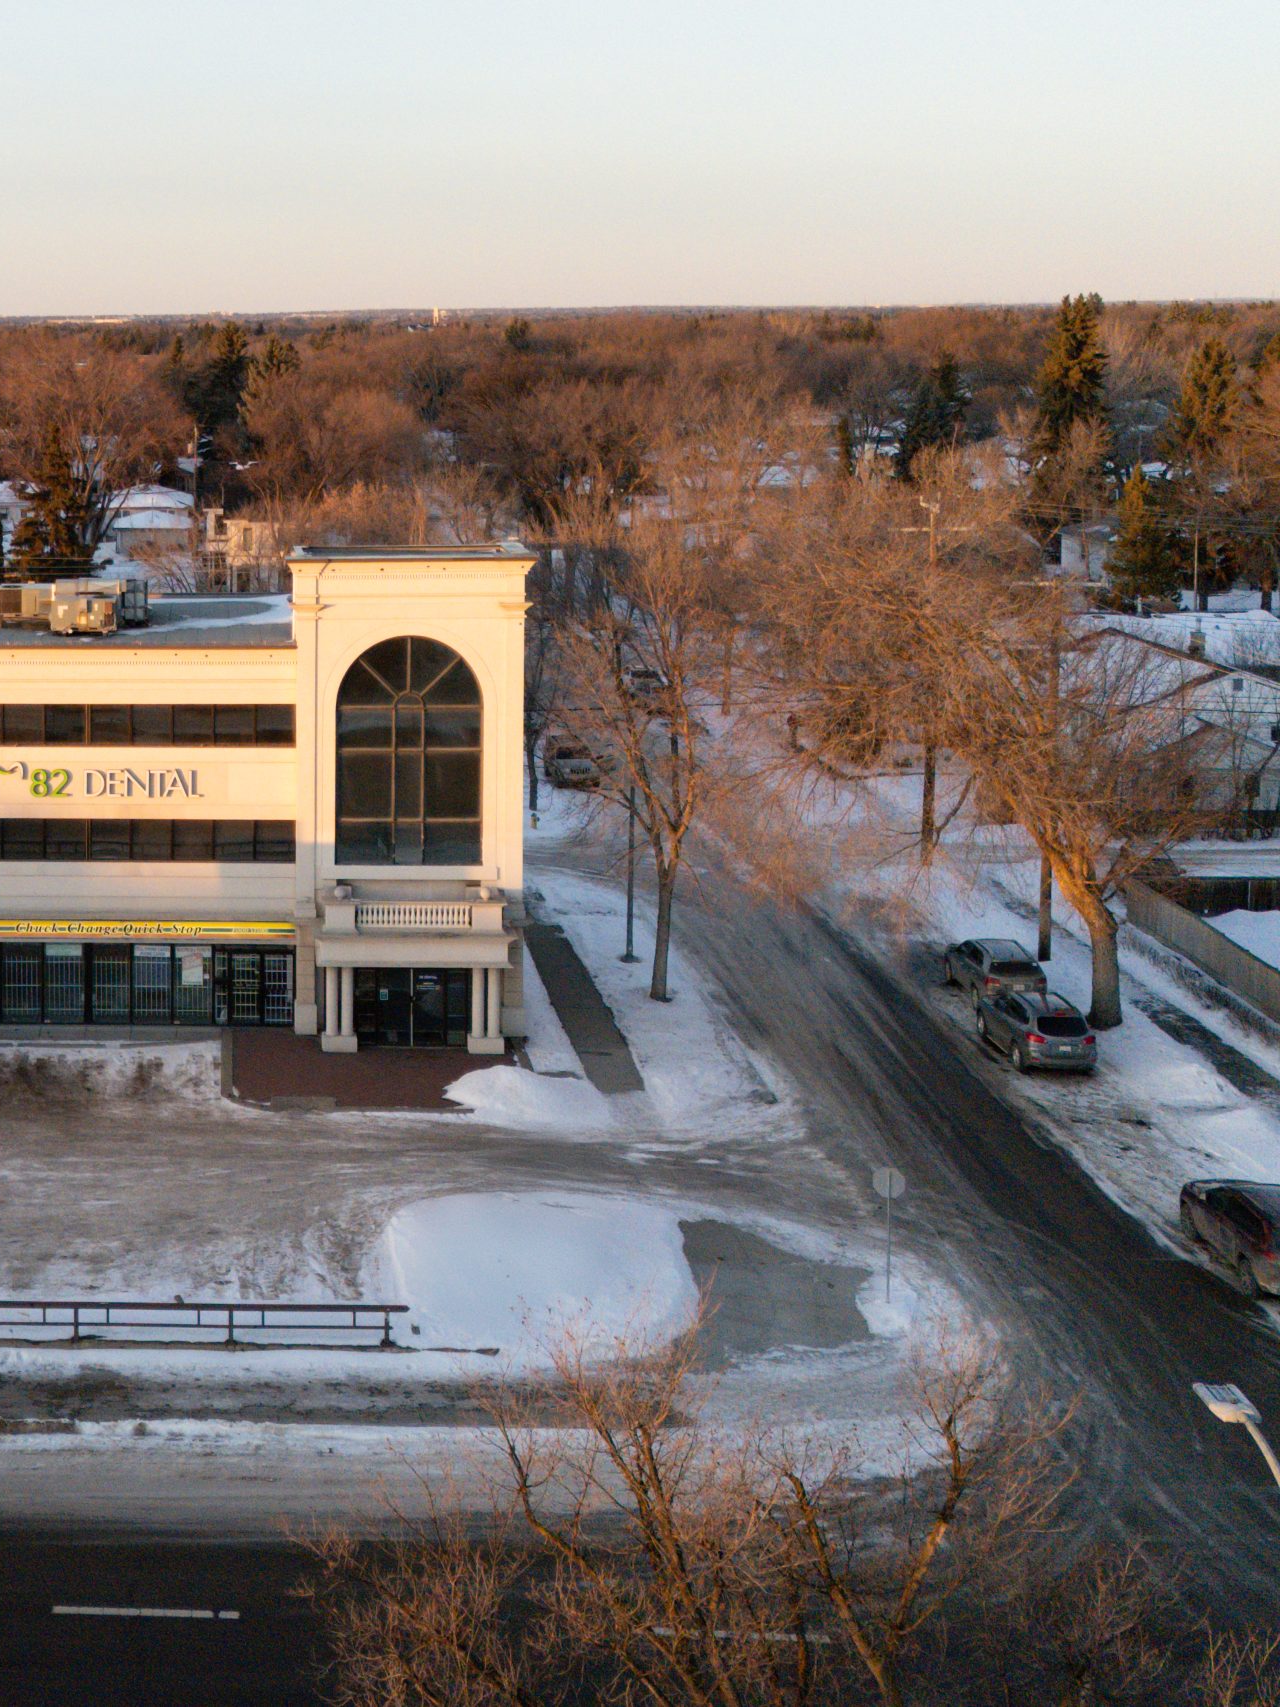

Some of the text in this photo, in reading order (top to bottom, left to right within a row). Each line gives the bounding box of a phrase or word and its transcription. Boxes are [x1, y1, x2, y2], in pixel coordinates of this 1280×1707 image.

[30, 768, 203, 798] 82 DENTAL
[15, 921, 202, 936] Chuck Change Quick Stop
